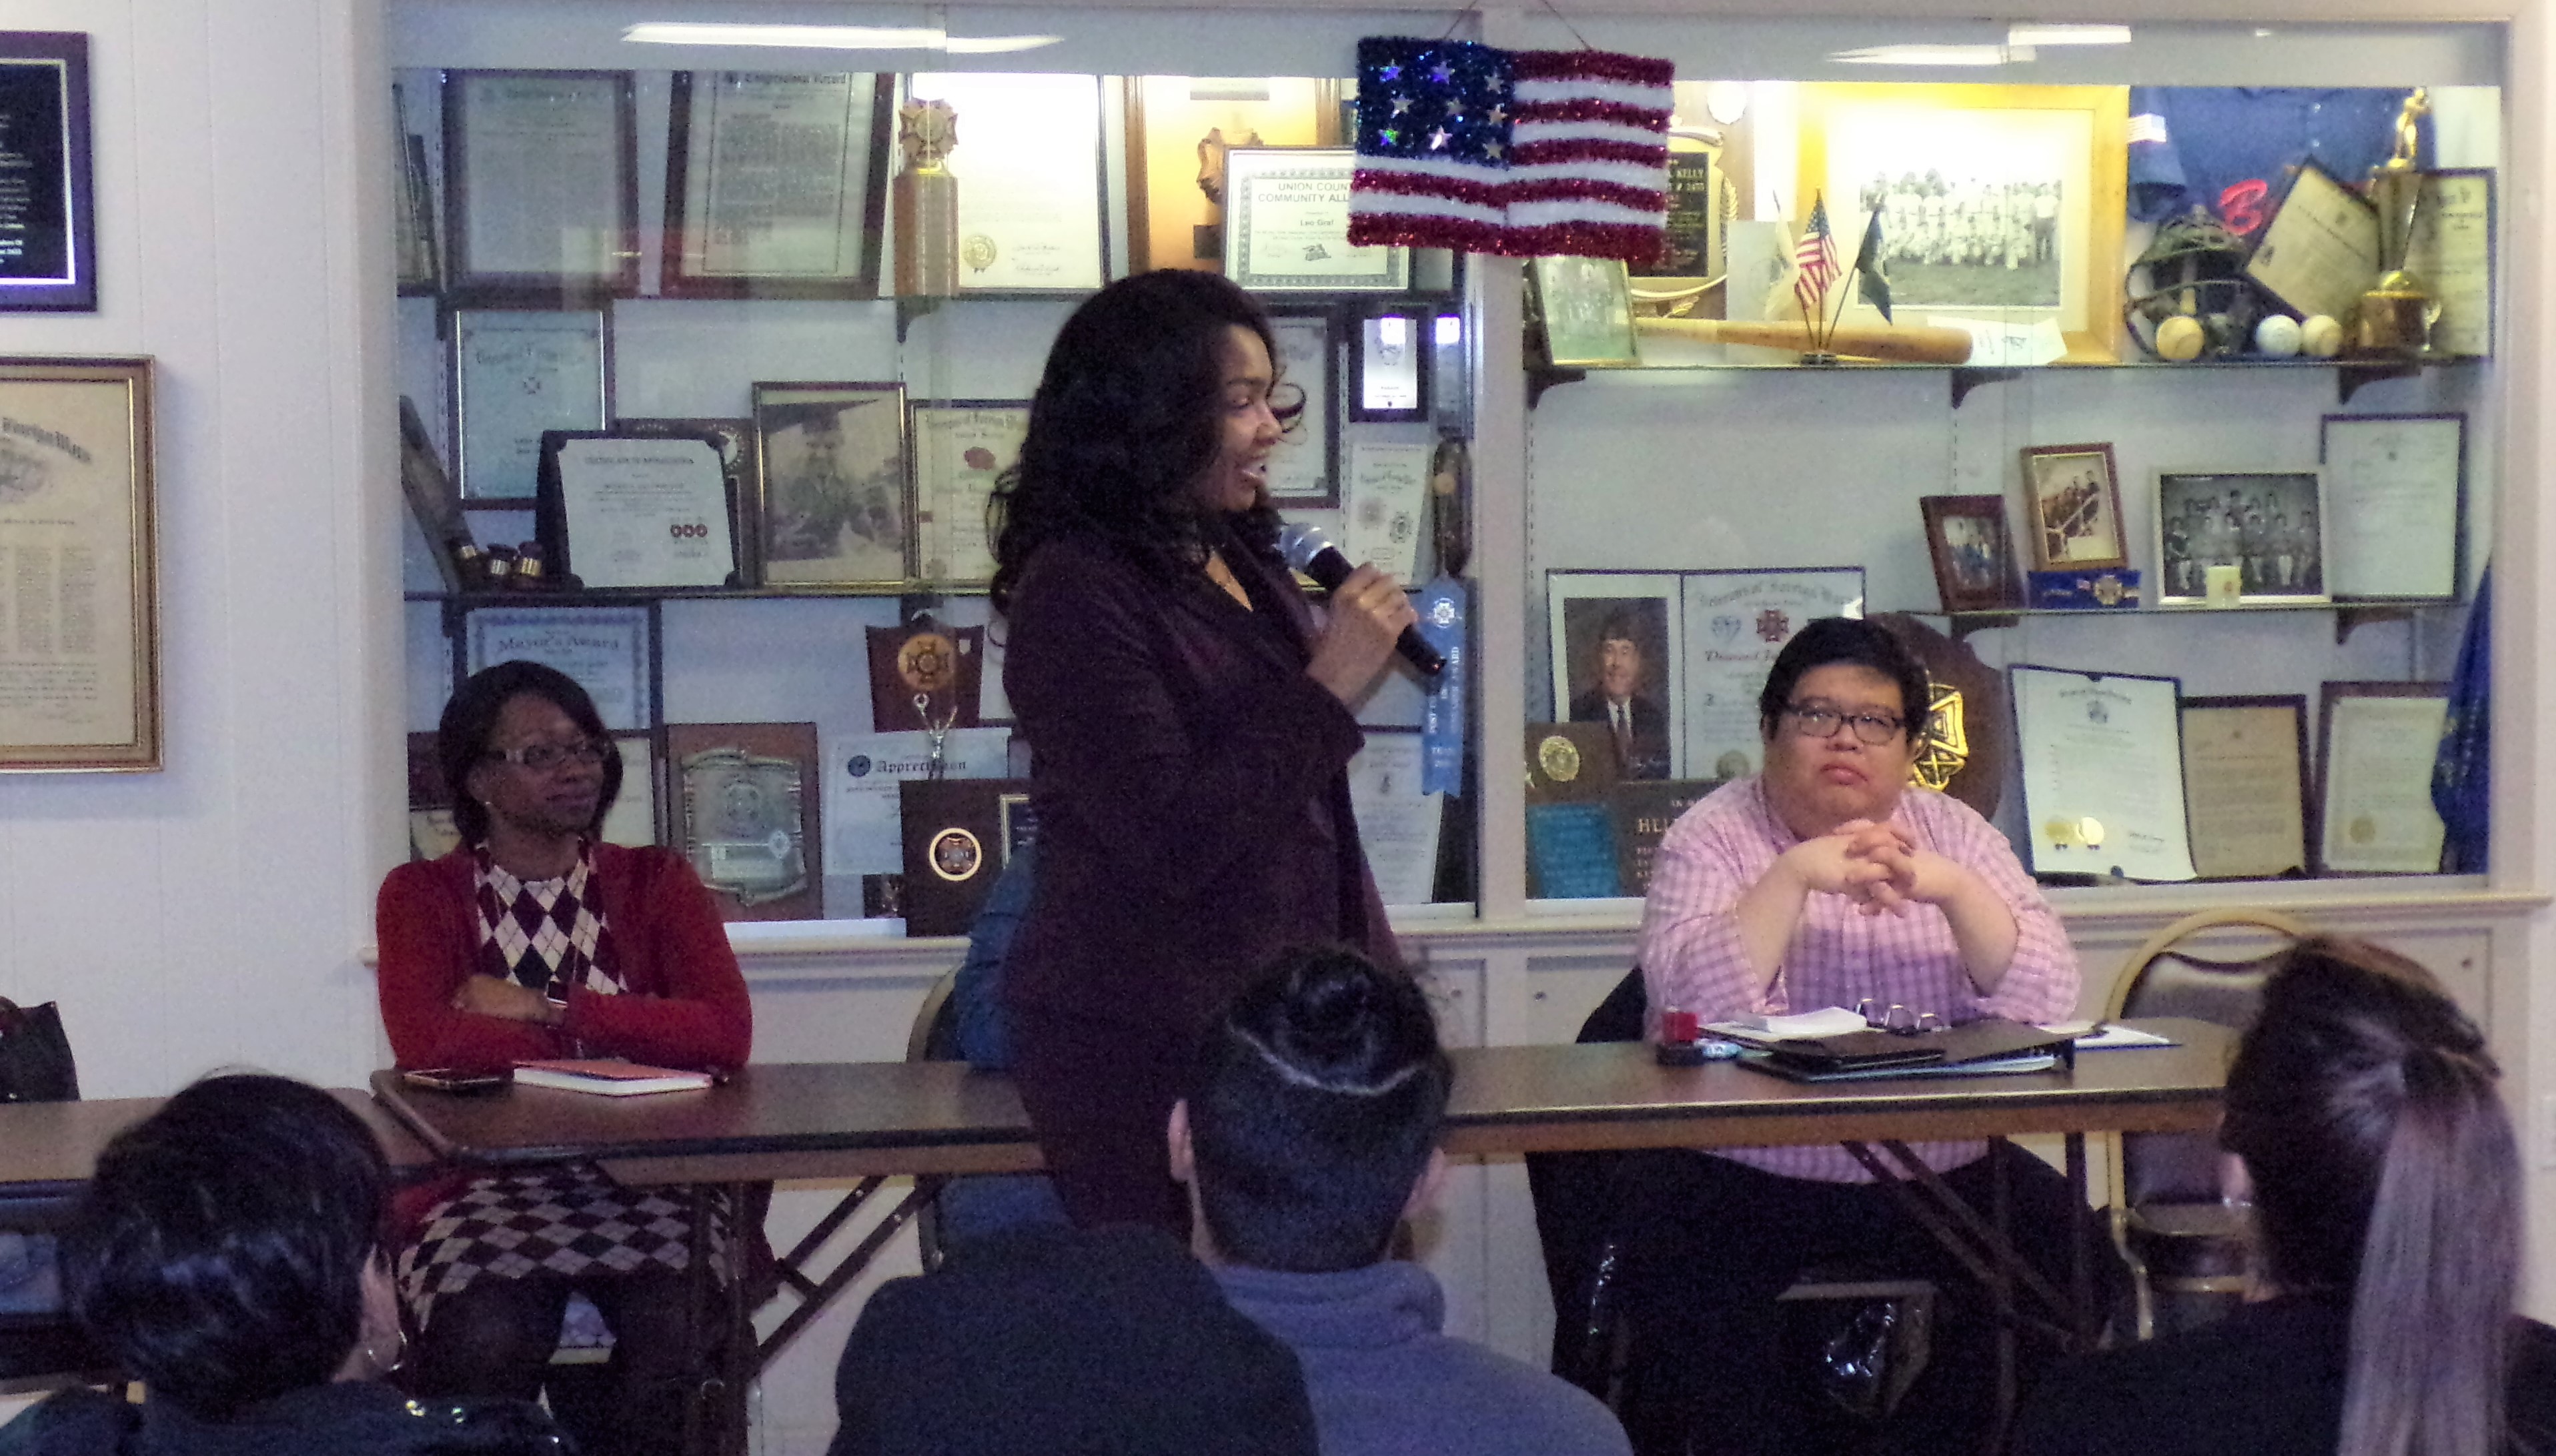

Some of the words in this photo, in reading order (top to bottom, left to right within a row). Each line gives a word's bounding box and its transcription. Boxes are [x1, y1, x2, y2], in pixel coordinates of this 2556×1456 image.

[1278, 182, 1313, 191] UNION
[1258, 193, 1325, 202] COMMUNITY
[1329, 193, 1349, 202] ALL
[876, 760, 966, 773] Apprecion
